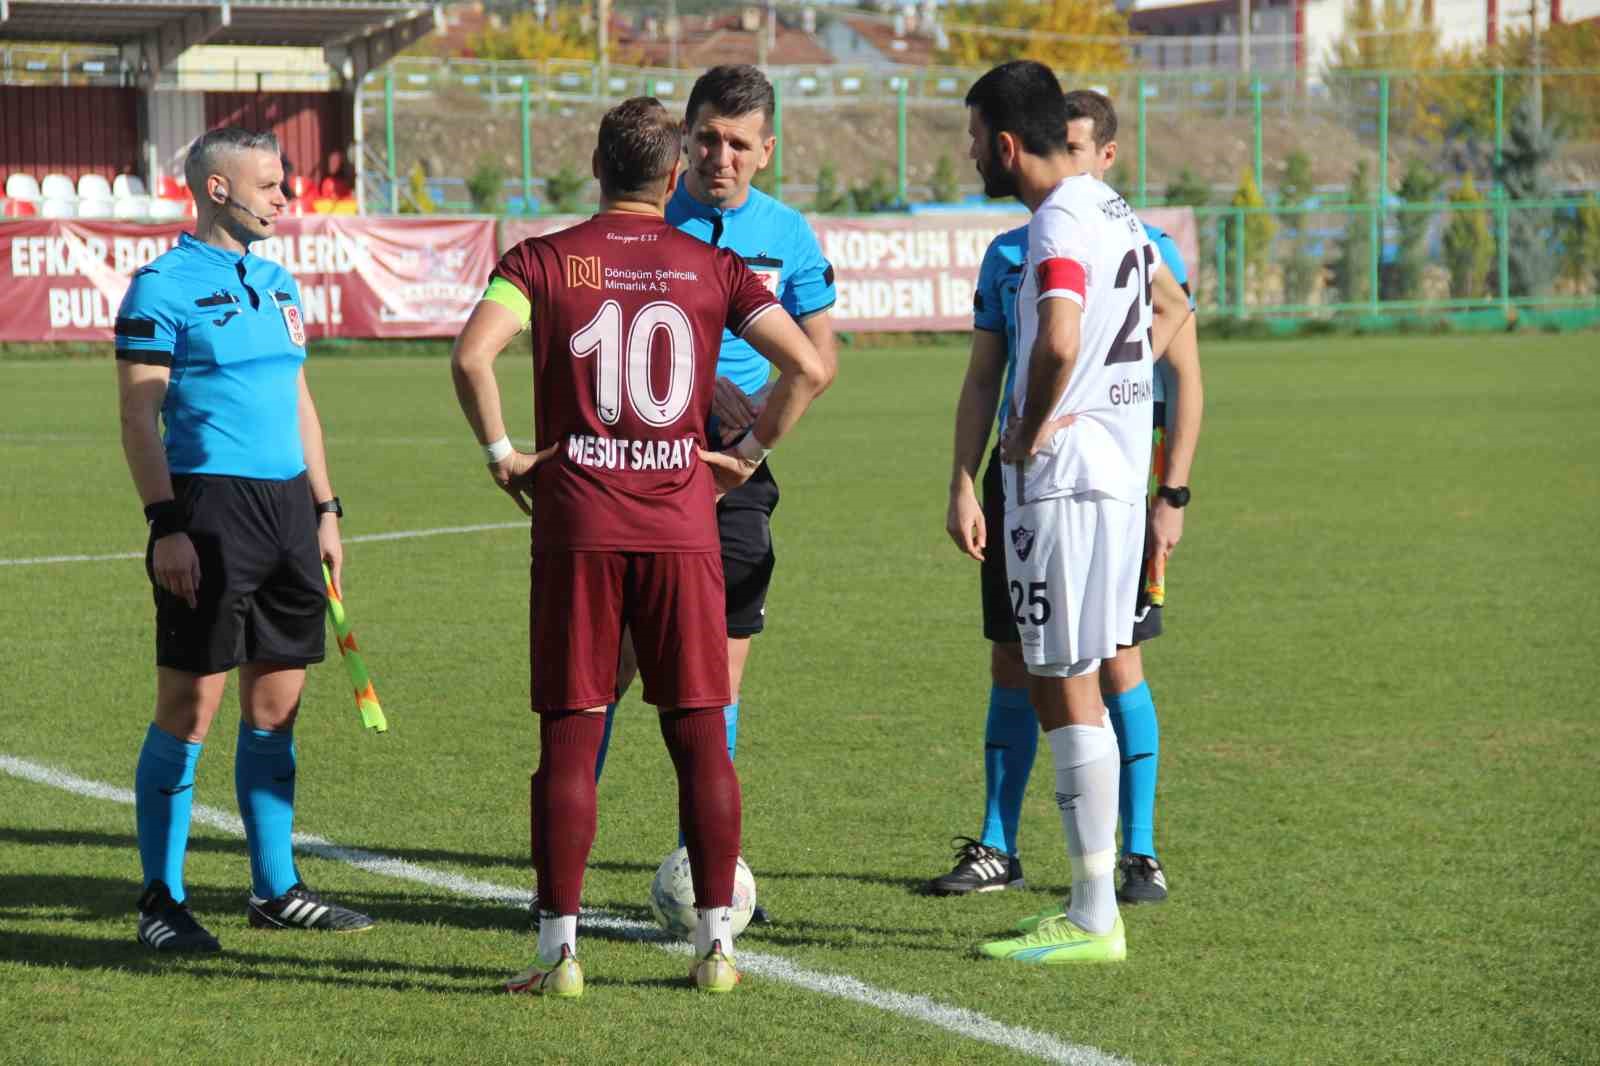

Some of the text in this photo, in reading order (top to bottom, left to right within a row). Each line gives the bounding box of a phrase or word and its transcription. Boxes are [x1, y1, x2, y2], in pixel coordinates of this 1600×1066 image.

[12, 237, 108, 277] EFKAR
[826, 230, 950, 269] KOPSUN
[605, 267, 698, 282] Dönüşüm Şehircilik
[605, 279, 671, 293] Mimarlık A.Ş.
[569, 299, 696, 428] 10
[567, 434, 695, 471] MESUT SARAY
[1010, 580, 1052, 627] 25
